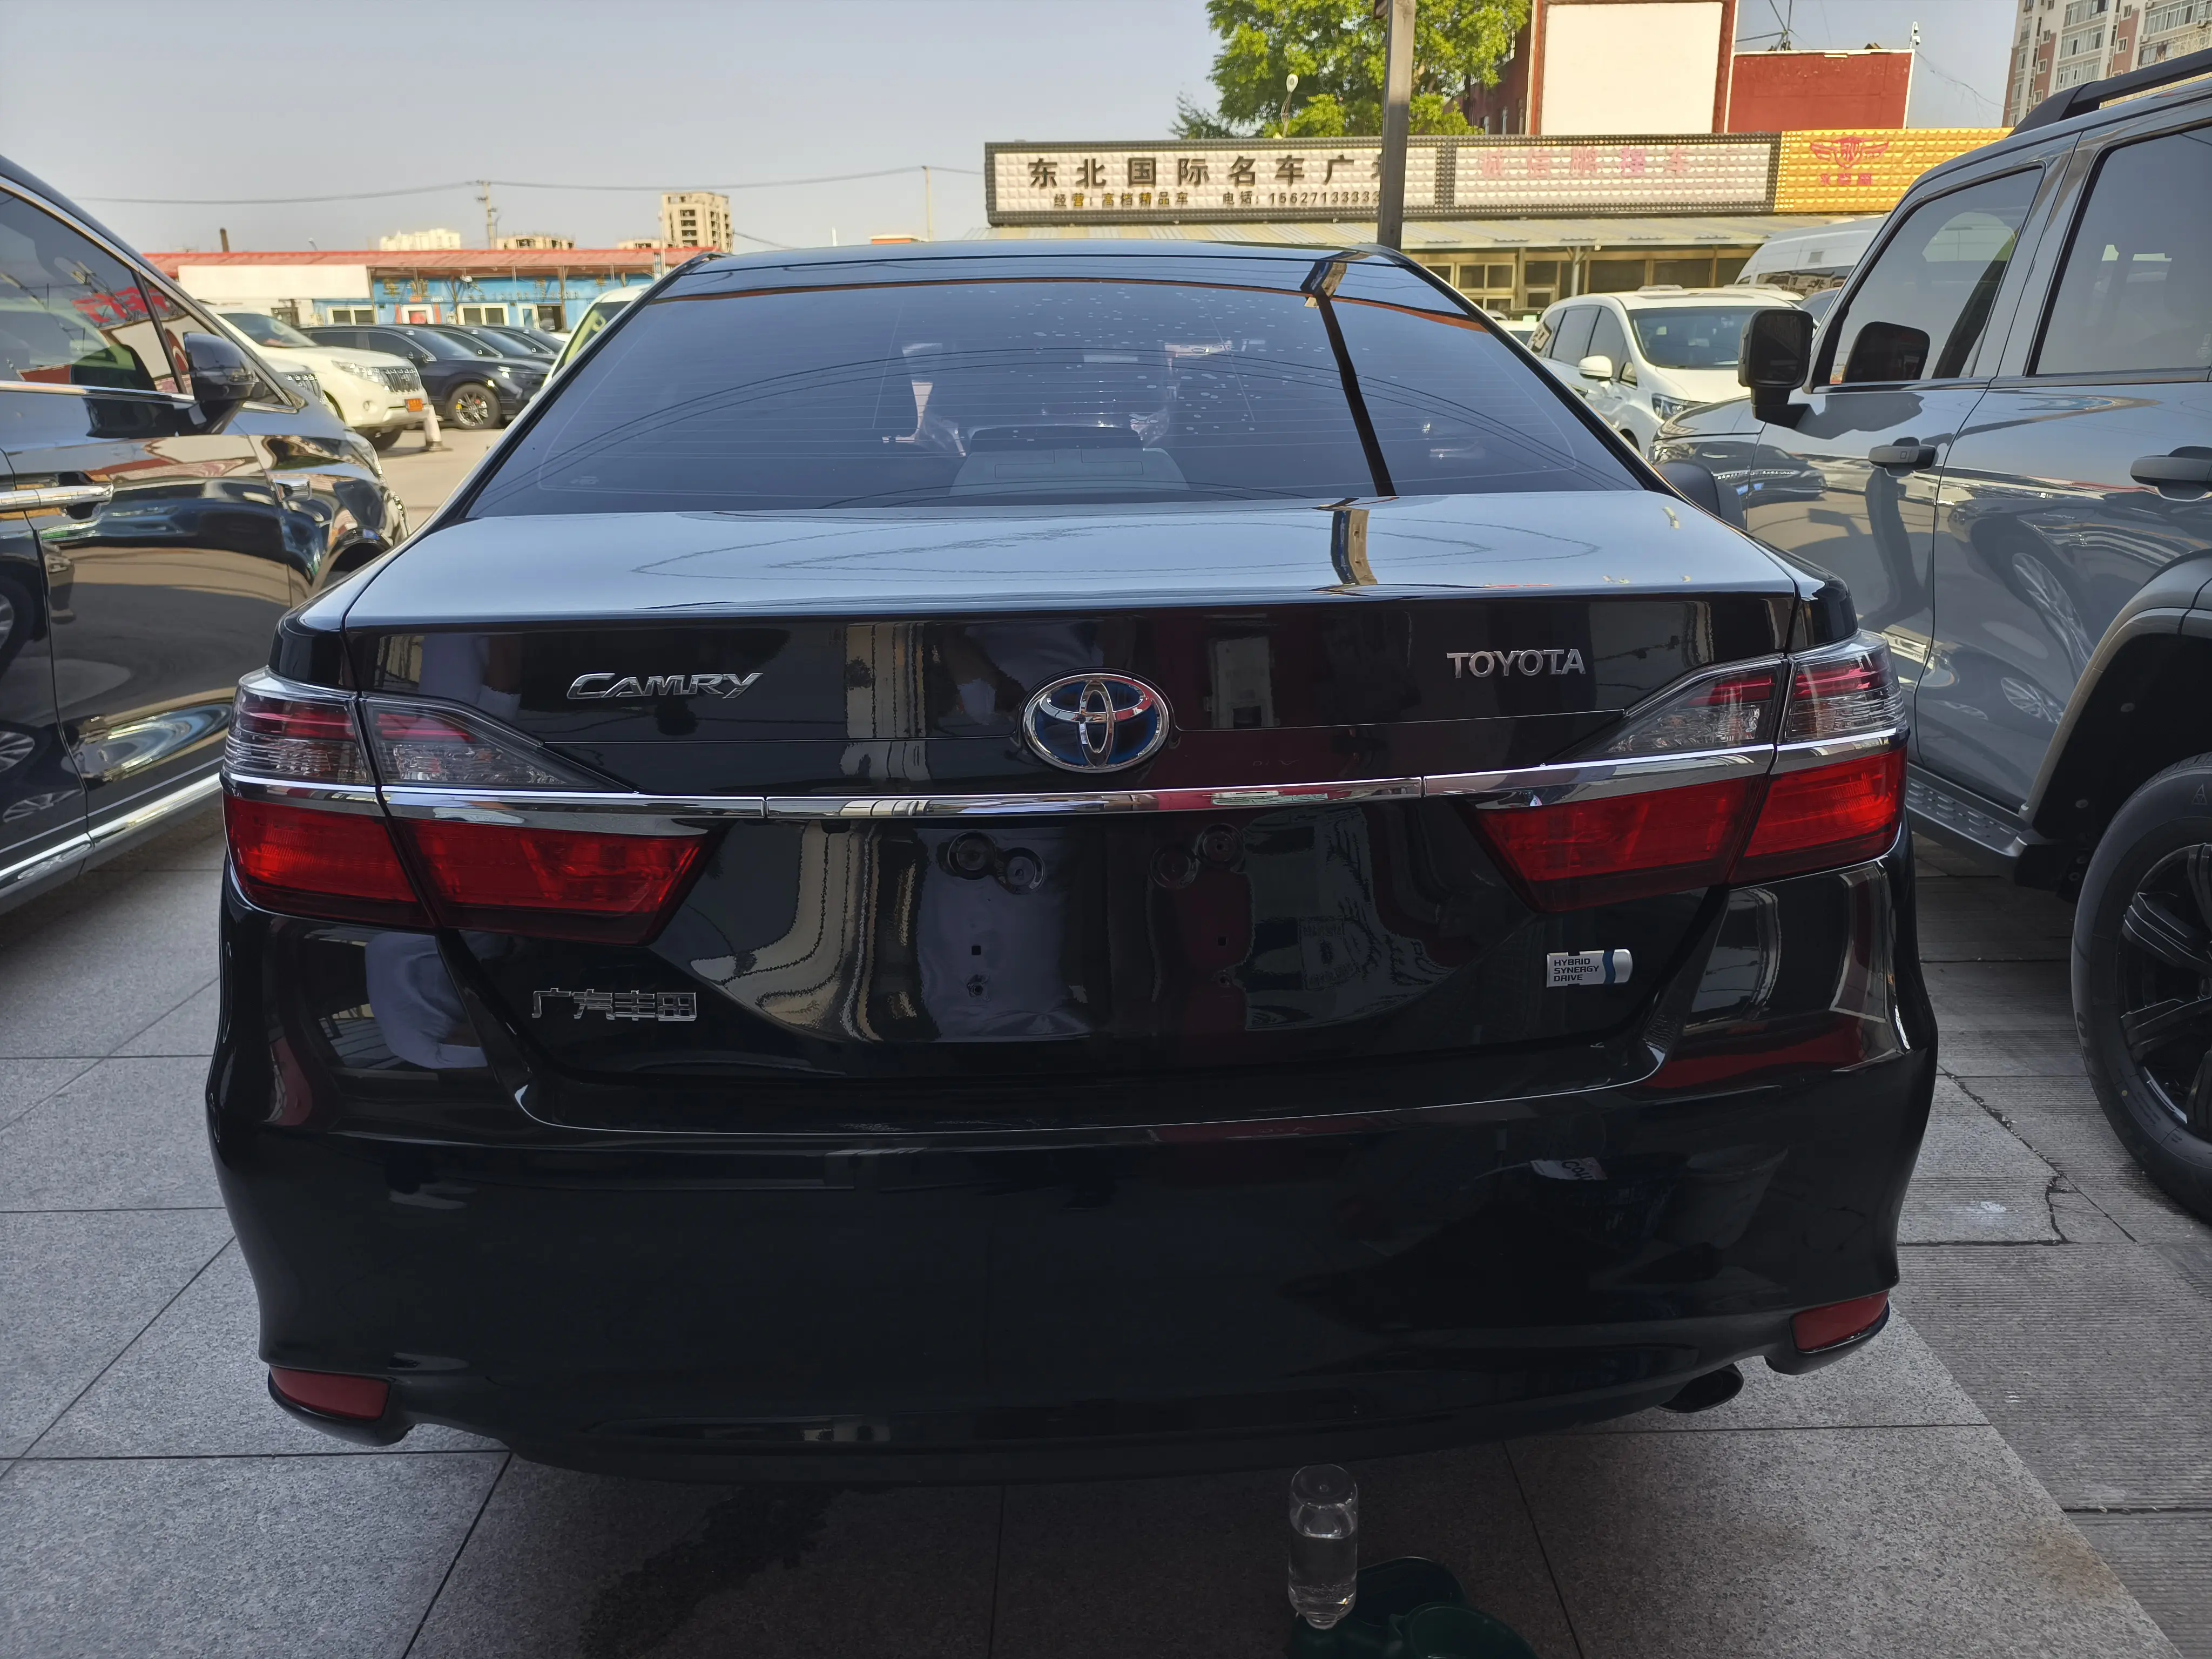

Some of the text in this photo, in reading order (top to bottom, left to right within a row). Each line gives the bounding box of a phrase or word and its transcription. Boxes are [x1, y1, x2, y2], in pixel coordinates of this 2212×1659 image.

[1447, 649, 1586, 678] TOYOTA
[567, 673, 763, 699] CAMRY
[1554, 958, 1590, 966] HYBRID
[1554, 966, 1600, 974] SYNERGY
[532, 988, 697, 1022] 广汽丰田
